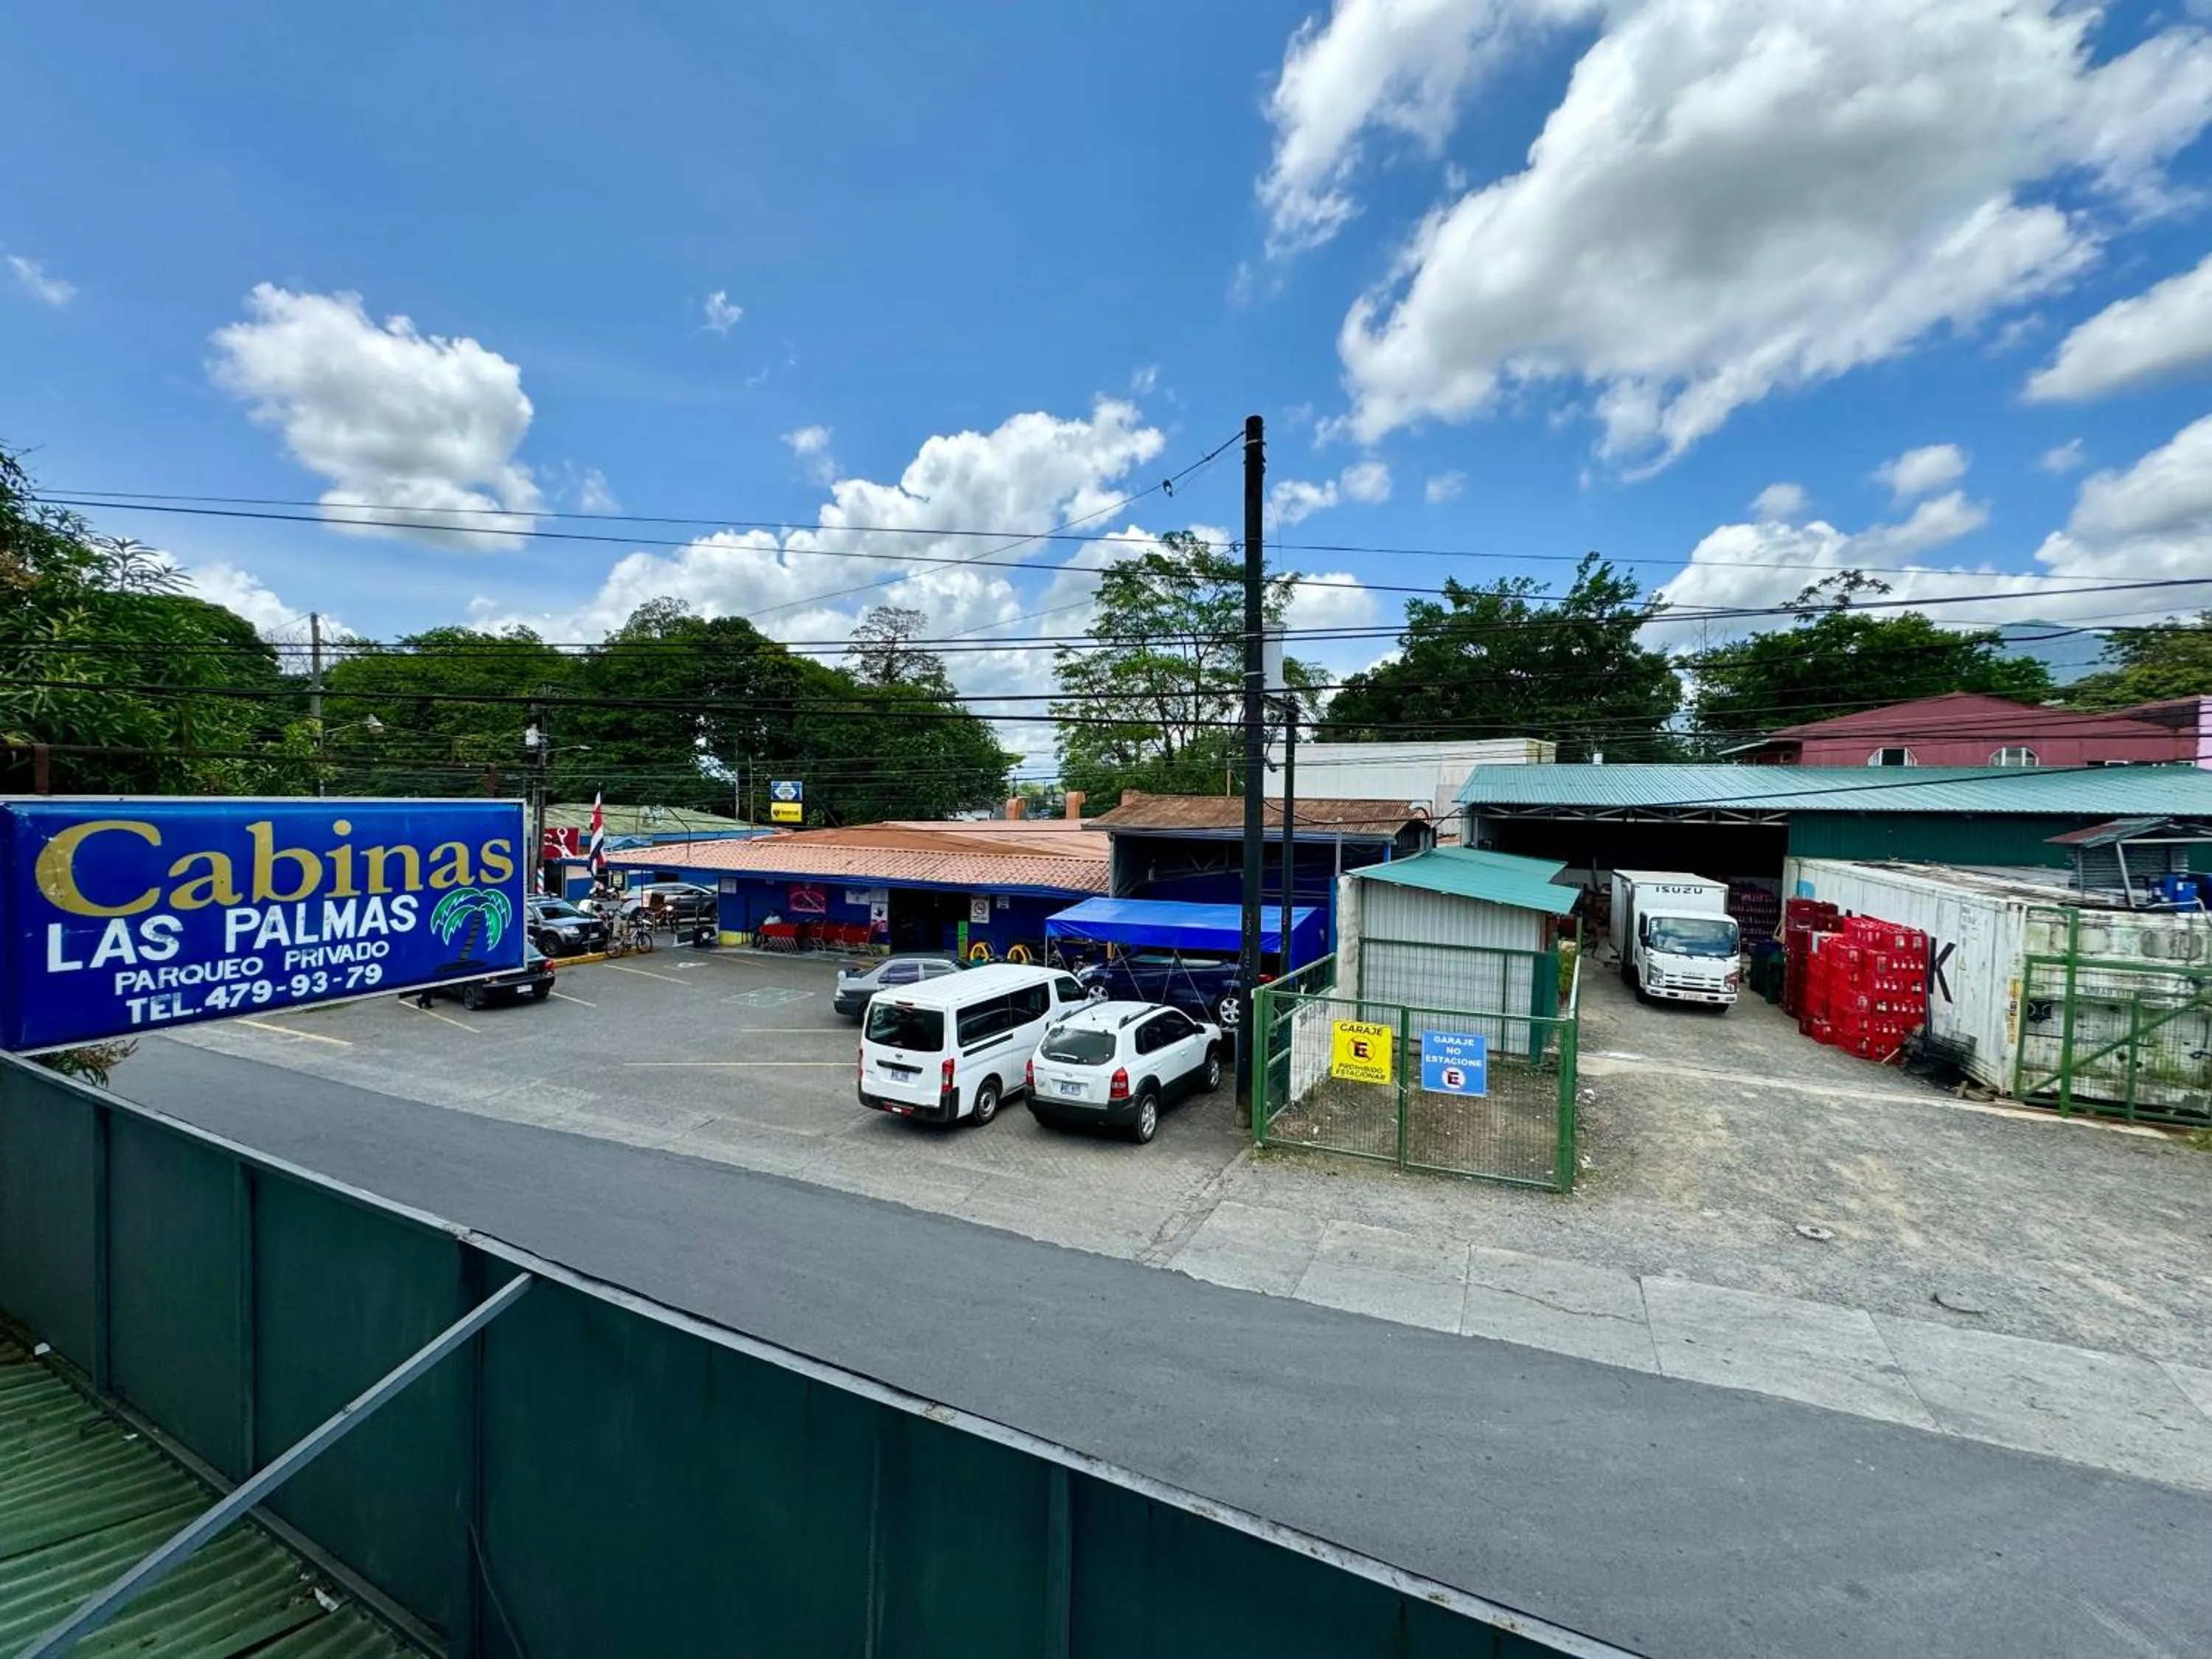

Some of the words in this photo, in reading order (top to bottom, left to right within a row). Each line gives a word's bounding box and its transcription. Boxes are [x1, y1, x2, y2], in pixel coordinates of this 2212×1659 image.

[35, 819, 514, 917] Cabinas
[1656, 886, 1703, 894] ISUZU
[46, 914, 184, 973] LAS
[225, 894, 419, 953] PALMAS
[115, 957, 263, 995] PARQUEO
[285, 941, 390, 970] PRIVADO
[1340, 1023, 1383, 1036] GARAJE
[1433, 1035, 1475, 1046] GARAJE
[1446, 1046, 1462, 1056] NO
[1425, 1054, 1483, 1068] ESTACIONE
